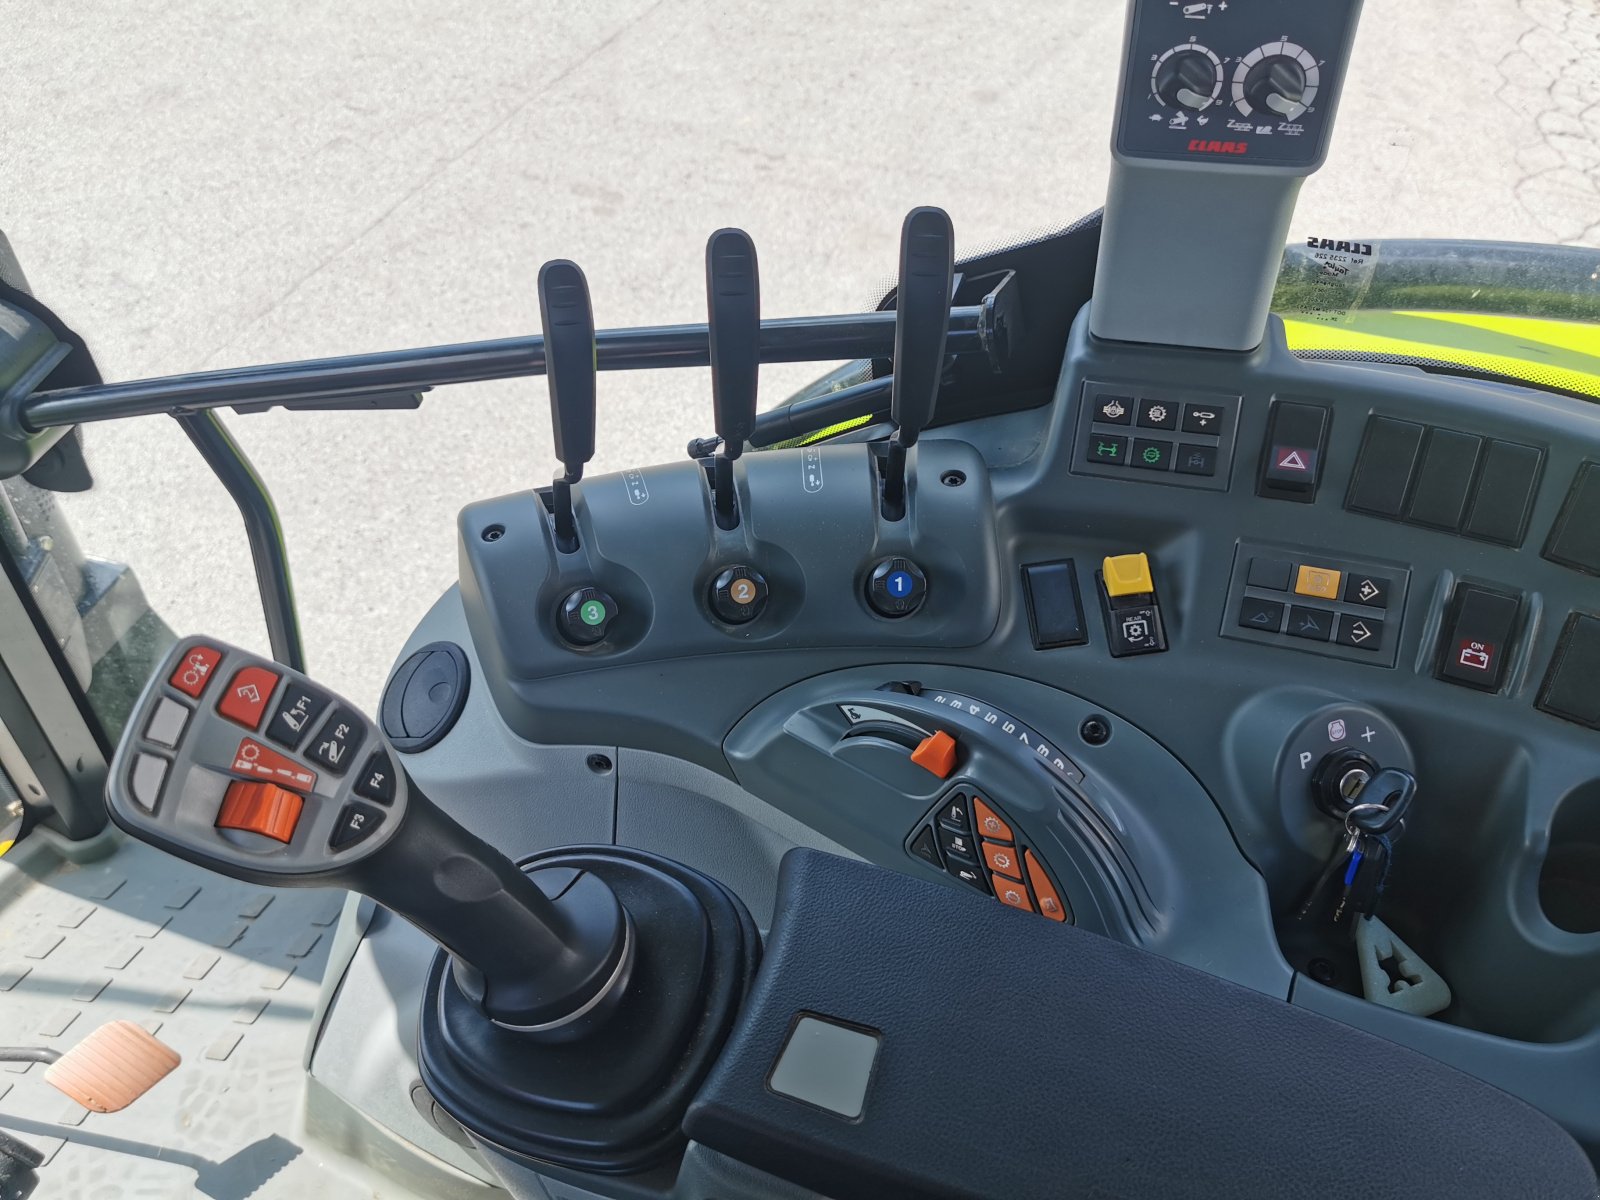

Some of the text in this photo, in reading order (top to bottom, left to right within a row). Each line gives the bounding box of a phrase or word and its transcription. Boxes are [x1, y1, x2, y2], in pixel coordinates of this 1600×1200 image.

[1188, 139, 1248, 154] CLAAS
[737, 584, 749, 599] 2
[895, 577, 903, 592] 1
[587, 605, 599, 620] 3
[1470, 642, 1485, 651] ON
[296, 696, 312, 711] F1
[950, 700, 963, 709] 3
[969, 705, 980, 715] 4
[984, 712, 998, 724] 5
[1002, 721, 1016, 734] 6
[1019, 732, 1030, 745] 7
[335, 723, 349, 740] F2
[1300, 751, 1312, 770] P
[370, 772, 384, 788] F4
[350, 814, 365, 830] F3
